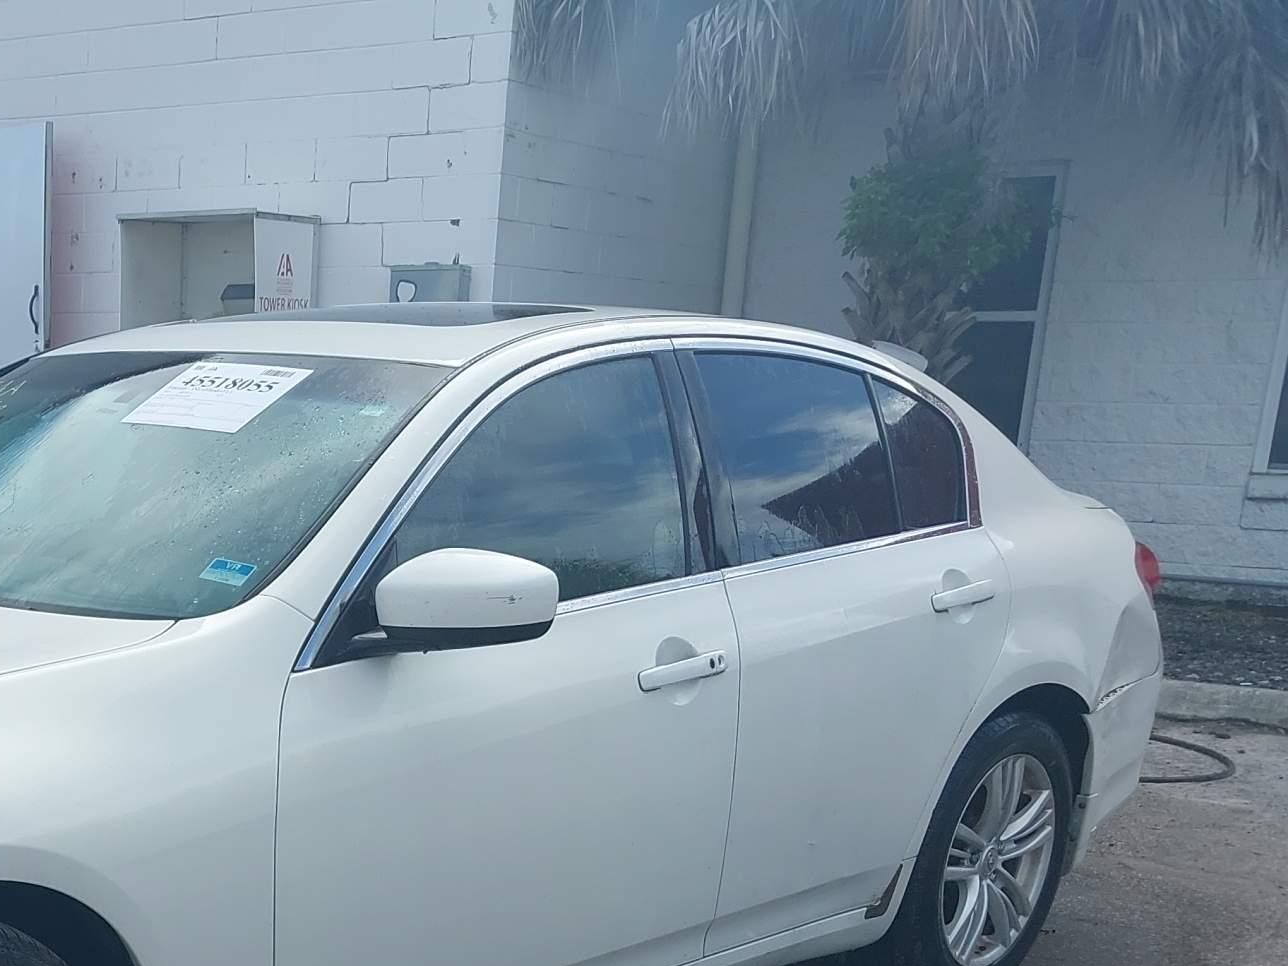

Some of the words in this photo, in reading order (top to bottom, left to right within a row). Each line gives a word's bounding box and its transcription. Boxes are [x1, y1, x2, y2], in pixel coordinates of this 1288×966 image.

[259, 296, 286, 312] TOWER
[287, 297, 309, 311] KIOSK
[182, 375, 280, 393] 45518055
